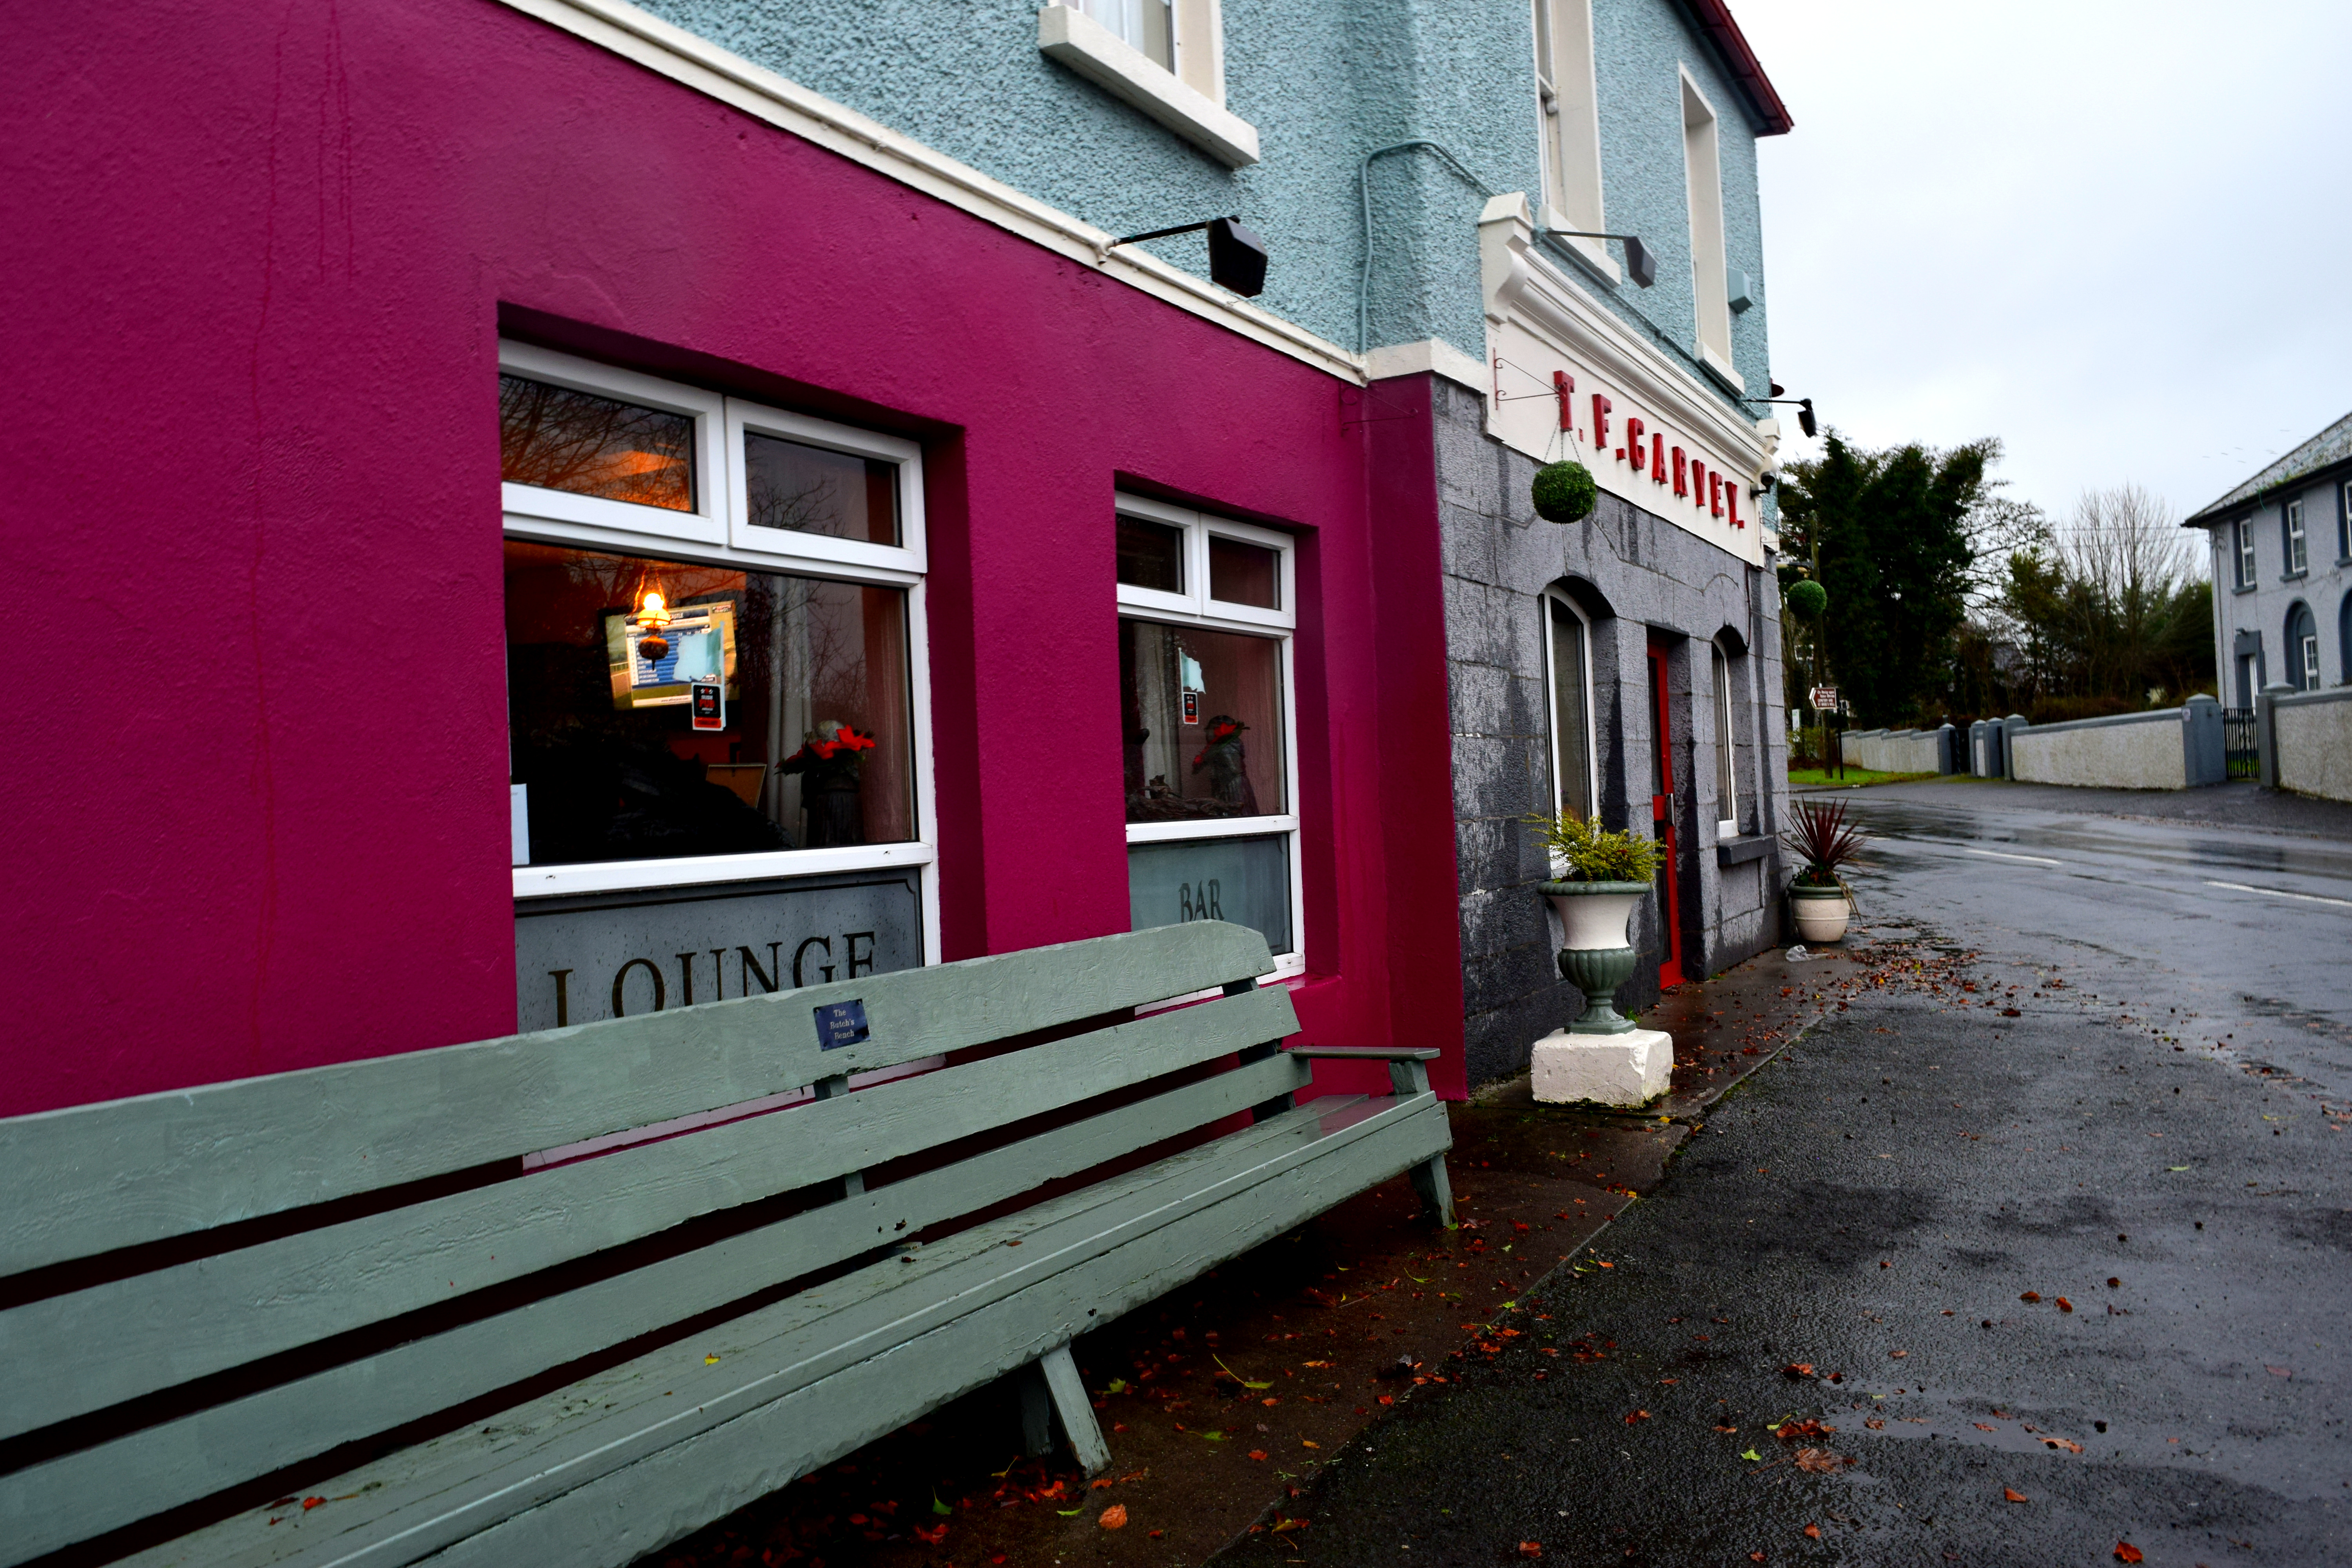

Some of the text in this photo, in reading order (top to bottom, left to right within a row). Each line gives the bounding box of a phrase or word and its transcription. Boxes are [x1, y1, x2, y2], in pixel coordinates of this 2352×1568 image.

[1178, 879, 1225, 922] BAR
[833, 1009, 846, 1017] The
[830, 1018, 855, 1029] Butch's
[835, 1029, 855, 1040] Bench
